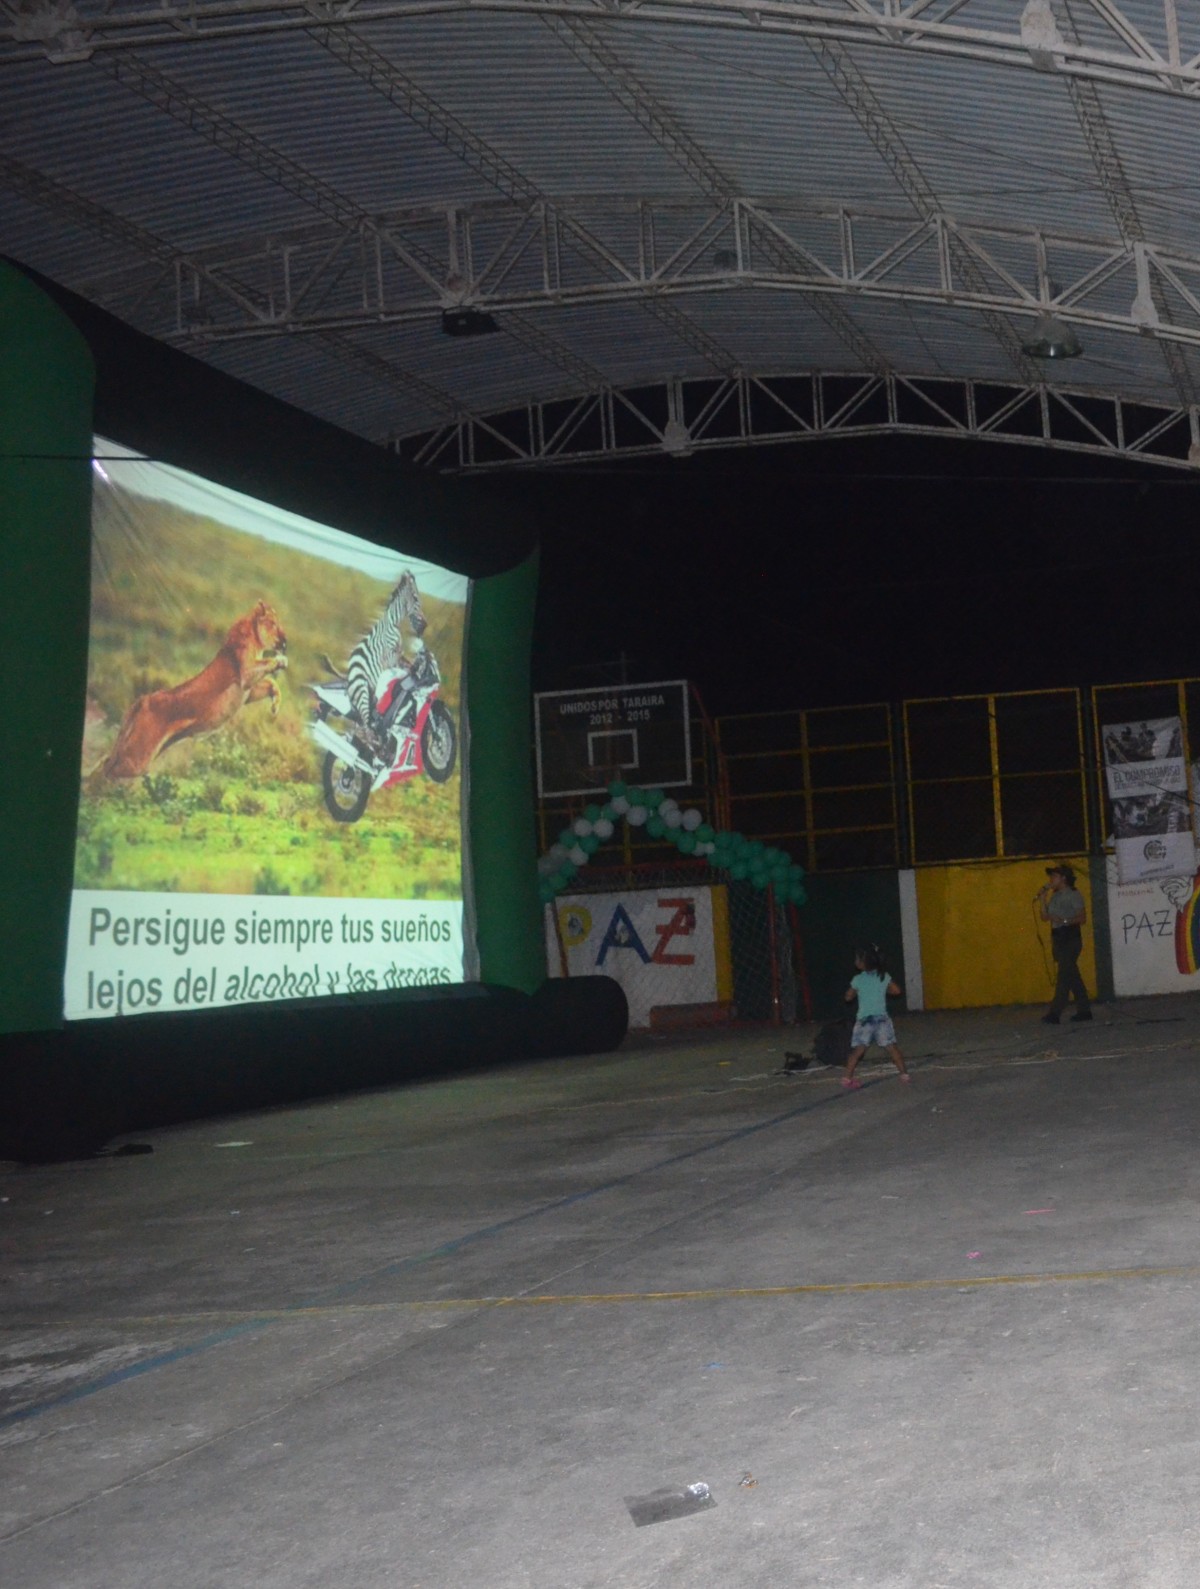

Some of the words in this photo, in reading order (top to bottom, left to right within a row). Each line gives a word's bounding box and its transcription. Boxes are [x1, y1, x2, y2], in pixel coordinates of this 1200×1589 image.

[560, 700, 597, 715] UNIDOS
[598, 698, 619, 711] POR
[622, 694, 665, 709] TARAIRA
[590, 712, 613, 725] 2012
[627, 709, 650, 721] 2015
[1113, 771, 1125, 784] EL
[89, 907, 226, 955] Persigue
[234, 910, 334, 952] siempre
[341, 912, 375, 944] tus
[381, 913, 452, 944] sueños
[557, 897, 696, 966] PAZ
[1121, 910, 1173, 945] PAZ
[86, 970, 163, 1016] lejos
[173, 967, 217, 1004] del
[224, 964, 320, 1001] alcohol
[327, 971, 340, 995] y
[346, 962, 378, 993] las
